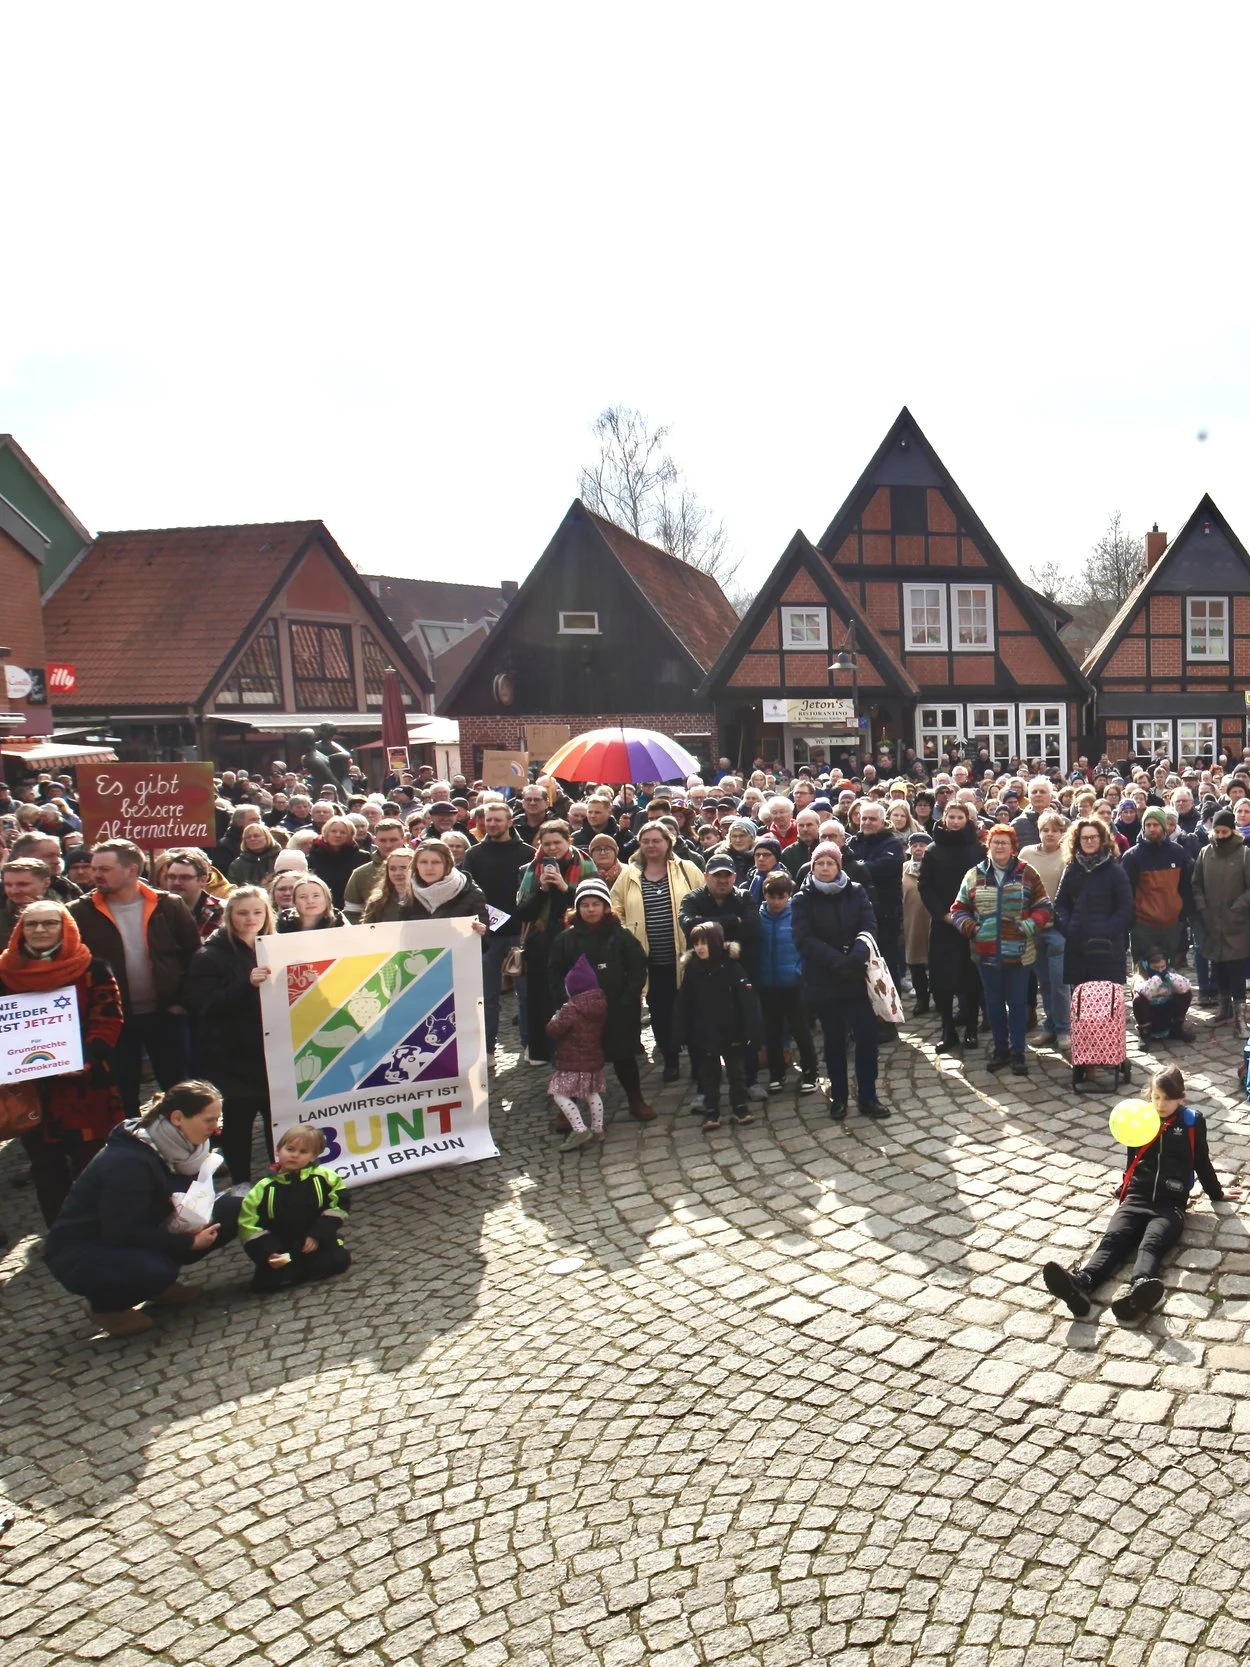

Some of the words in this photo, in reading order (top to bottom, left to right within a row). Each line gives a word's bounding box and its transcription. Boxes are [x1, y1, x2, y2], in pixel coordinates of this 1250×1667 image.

[50, 668, 75, 690] illy
[801, 700, 845, 711] Jeton's
[96, 774, 123, 796] Es
[134, 773, 179, 806] gibt
[120, 798, 184, 818] bessere
[0, 1007, 48, 1022] WIEDER
[0, 1022, 20, 1033] IST
[24, 1014, 64, 1029] JETZT
[7, 1040, 67, 1056] Grundrechte
[14, 1060, 70, 1075] Demokratie
[298, 1089, 433, 1124] LANDWIRTSCHAFT
[437, 1085, 460, 1097] IST
[334, 1157, 380, 1180] CHT
[387, 1137, 465, 1165] BRAUN
